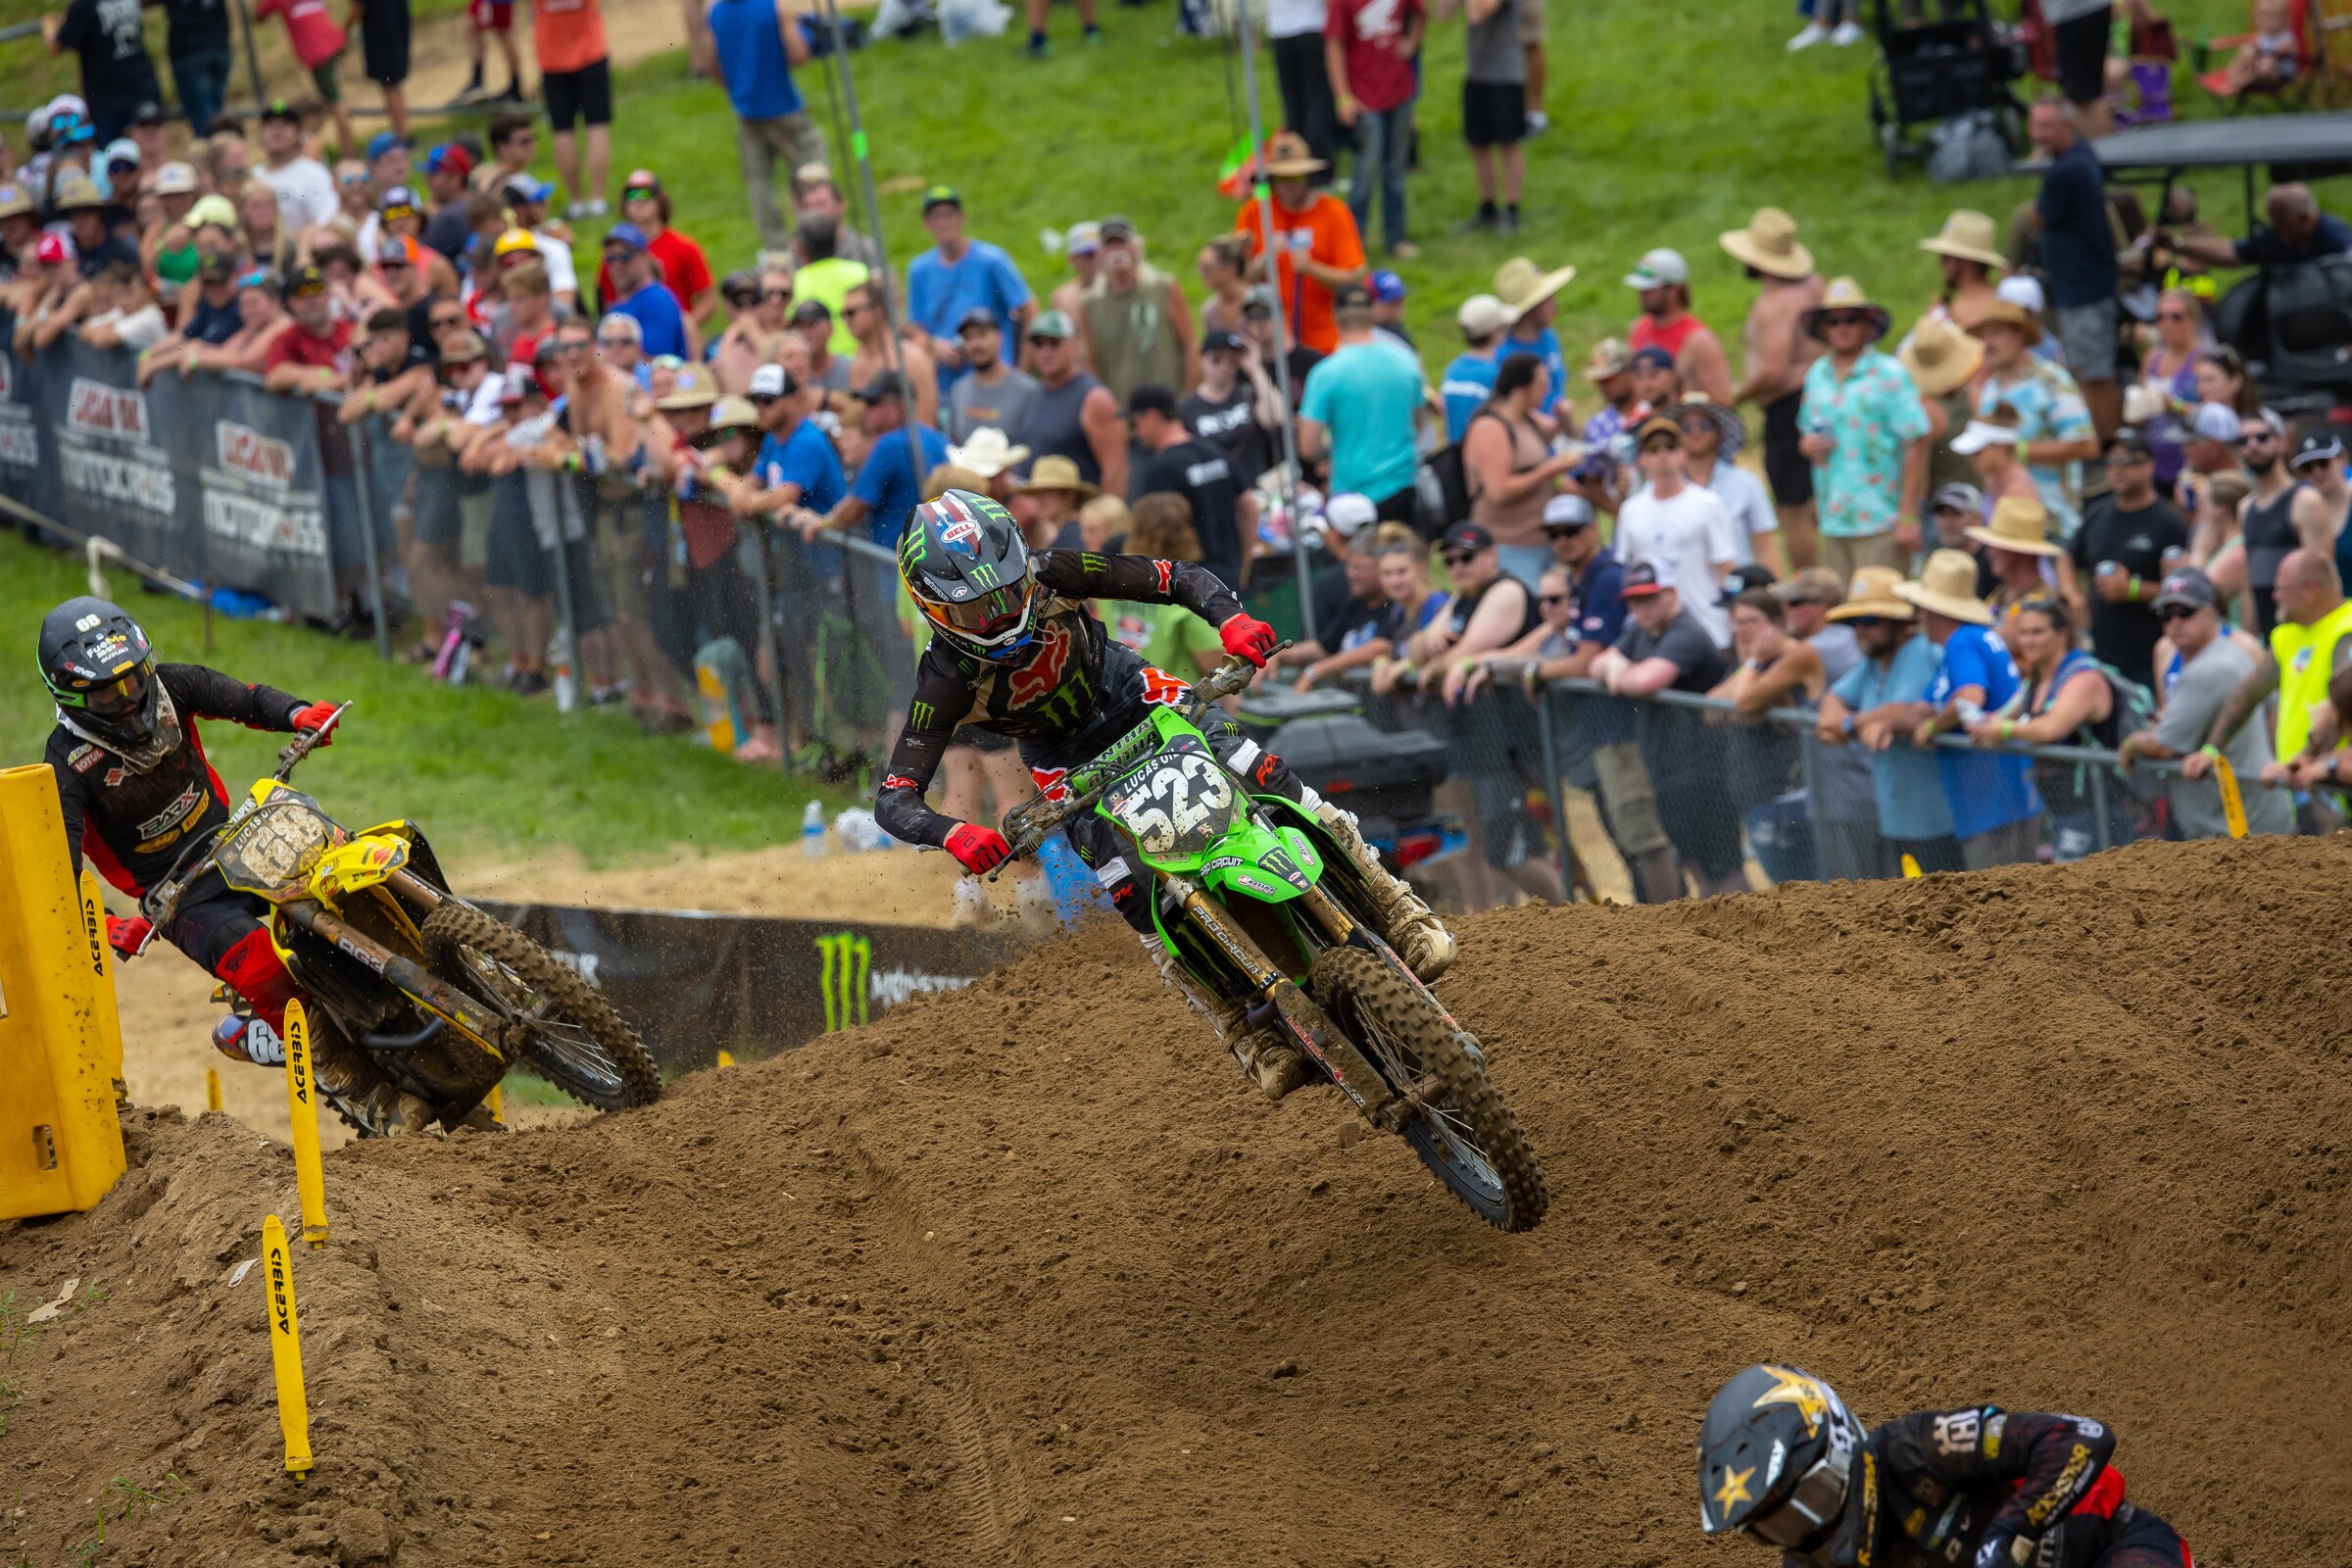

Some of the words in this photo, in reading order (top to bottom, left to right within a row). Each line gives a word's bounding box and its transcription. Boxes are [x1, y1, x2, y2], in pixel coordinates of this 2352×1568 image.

[947, 523, 972, 540] BELL
[75, 613, 101, 632] 68
[101, 647, 128, 663] SUZUKI
[1124, 760, 1159, 794] LUCAS
[1160, 748, 1180, 764] OIL
[1121, 751, 1234, 854] 523
[235, 817, 262, 851] LUCAS
[956, 830, 987, 857] FOX
[1211, 856, 1244, 870] CIRCUIT
[1113, 883, 1134, 903] OX
[86, 898, 104, 977] ACERBIS
[1192, 905, 1219, 935] PRO
[1217, 930, 1263, 976] CIRCUIT
[290, 1020, 309, 1104] ACERBIS
[270, 1247, 291, 1336] ACERBIS
[1976, 1539, 1999, 1566] LY
